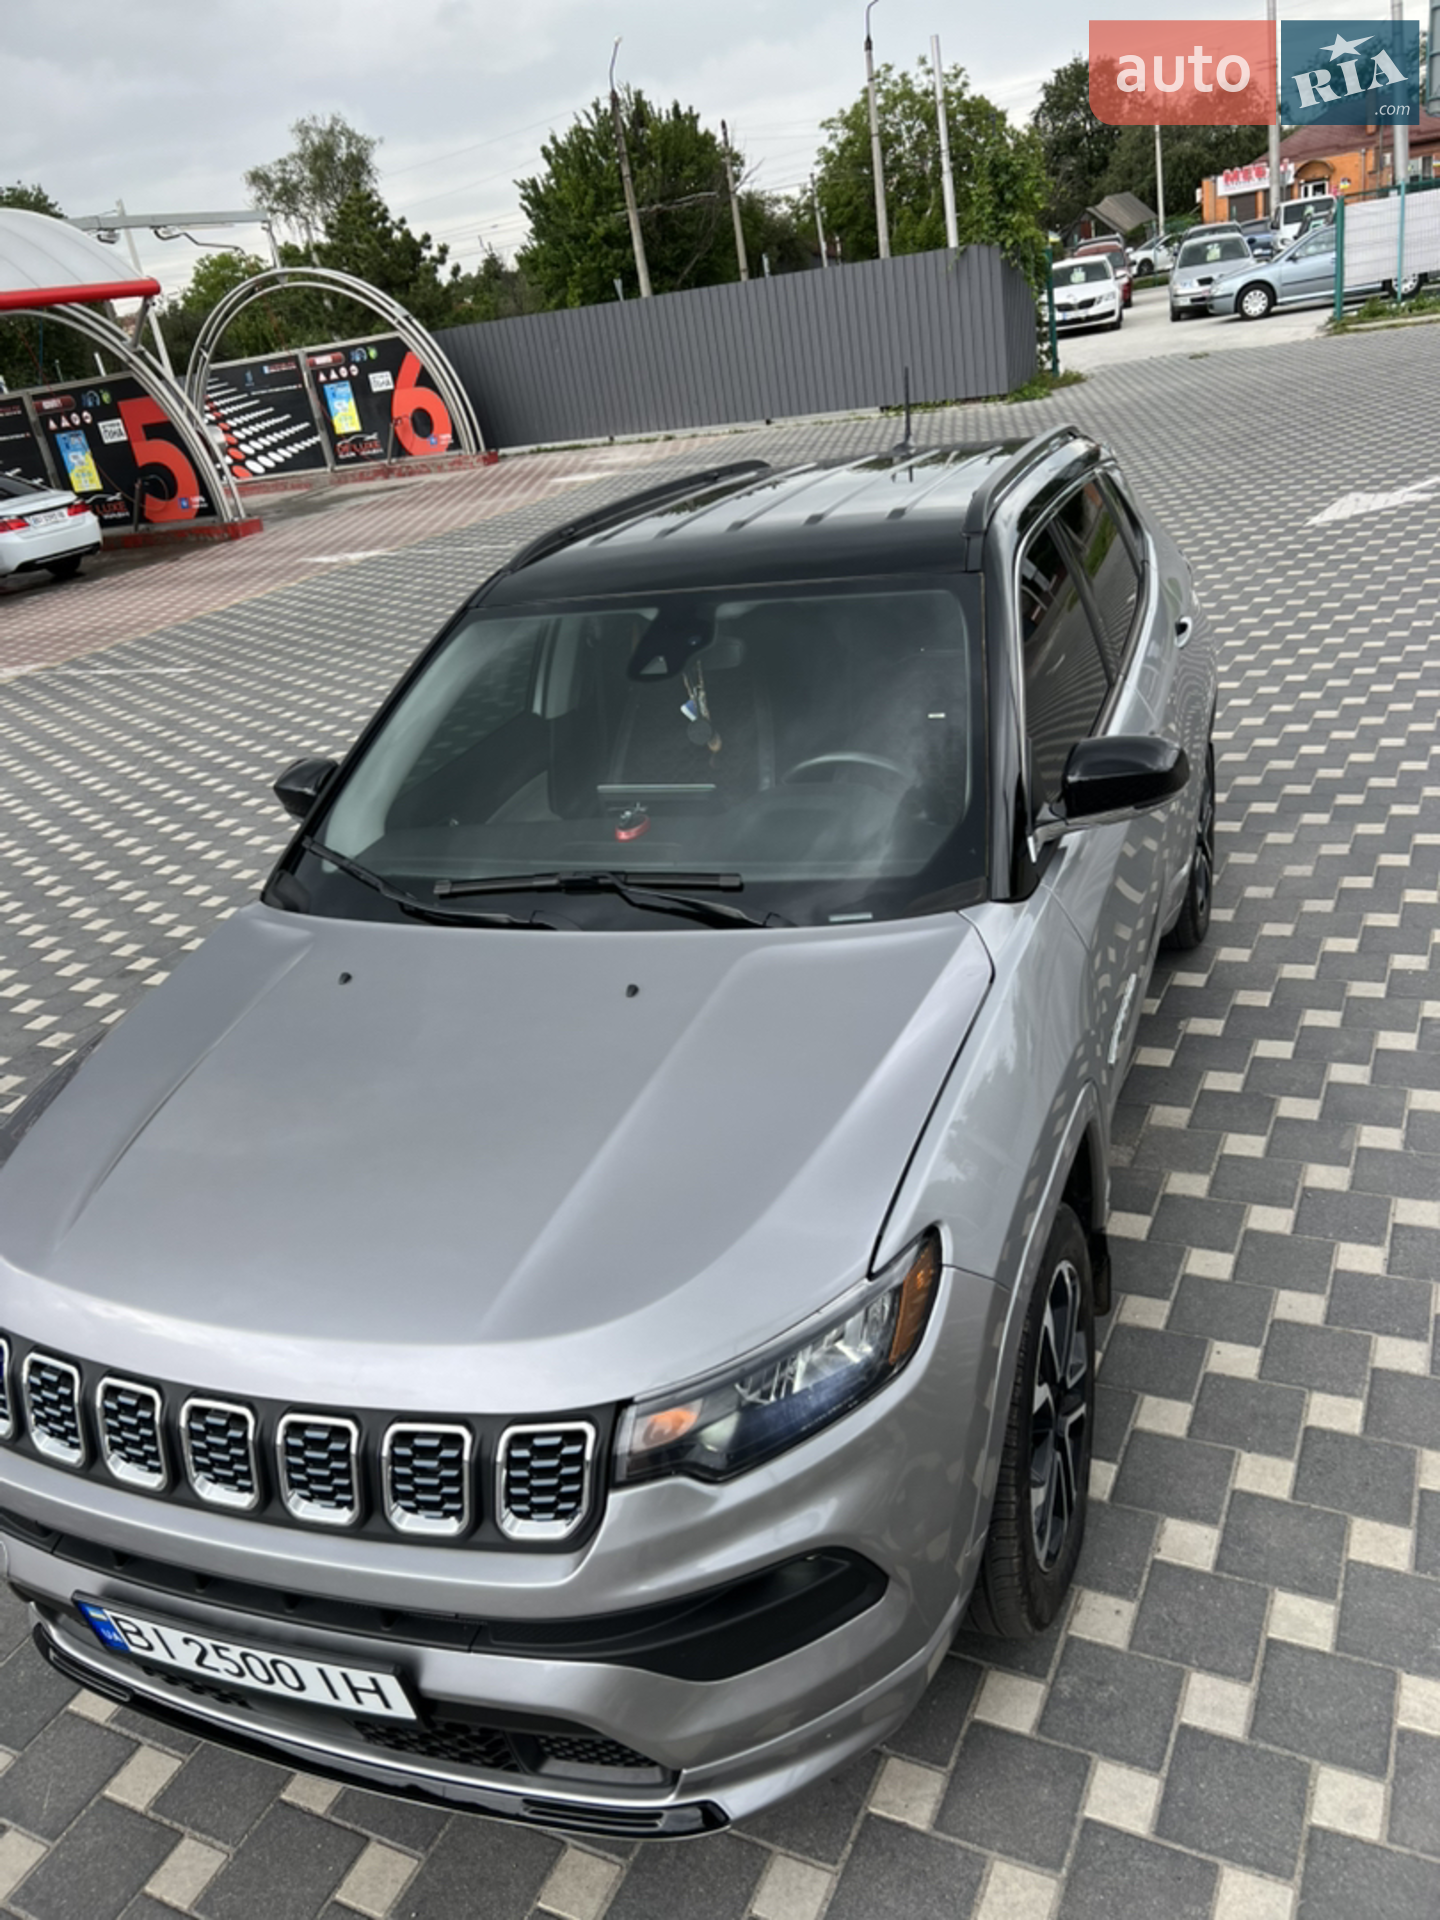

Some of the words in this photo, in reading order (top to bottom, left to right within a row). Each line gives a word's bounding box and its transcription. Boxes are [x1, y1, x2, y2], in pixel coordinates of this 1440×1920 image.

[392, 351, 452, 455] 6
[117, 396, 200, 523] 5
[101, 1628, 123, 1645] UA
[112, 1615, 175, 1660] BI
[183, 1637, 306, 1692] 2500
[318, 1667, 393, 1711] IH
